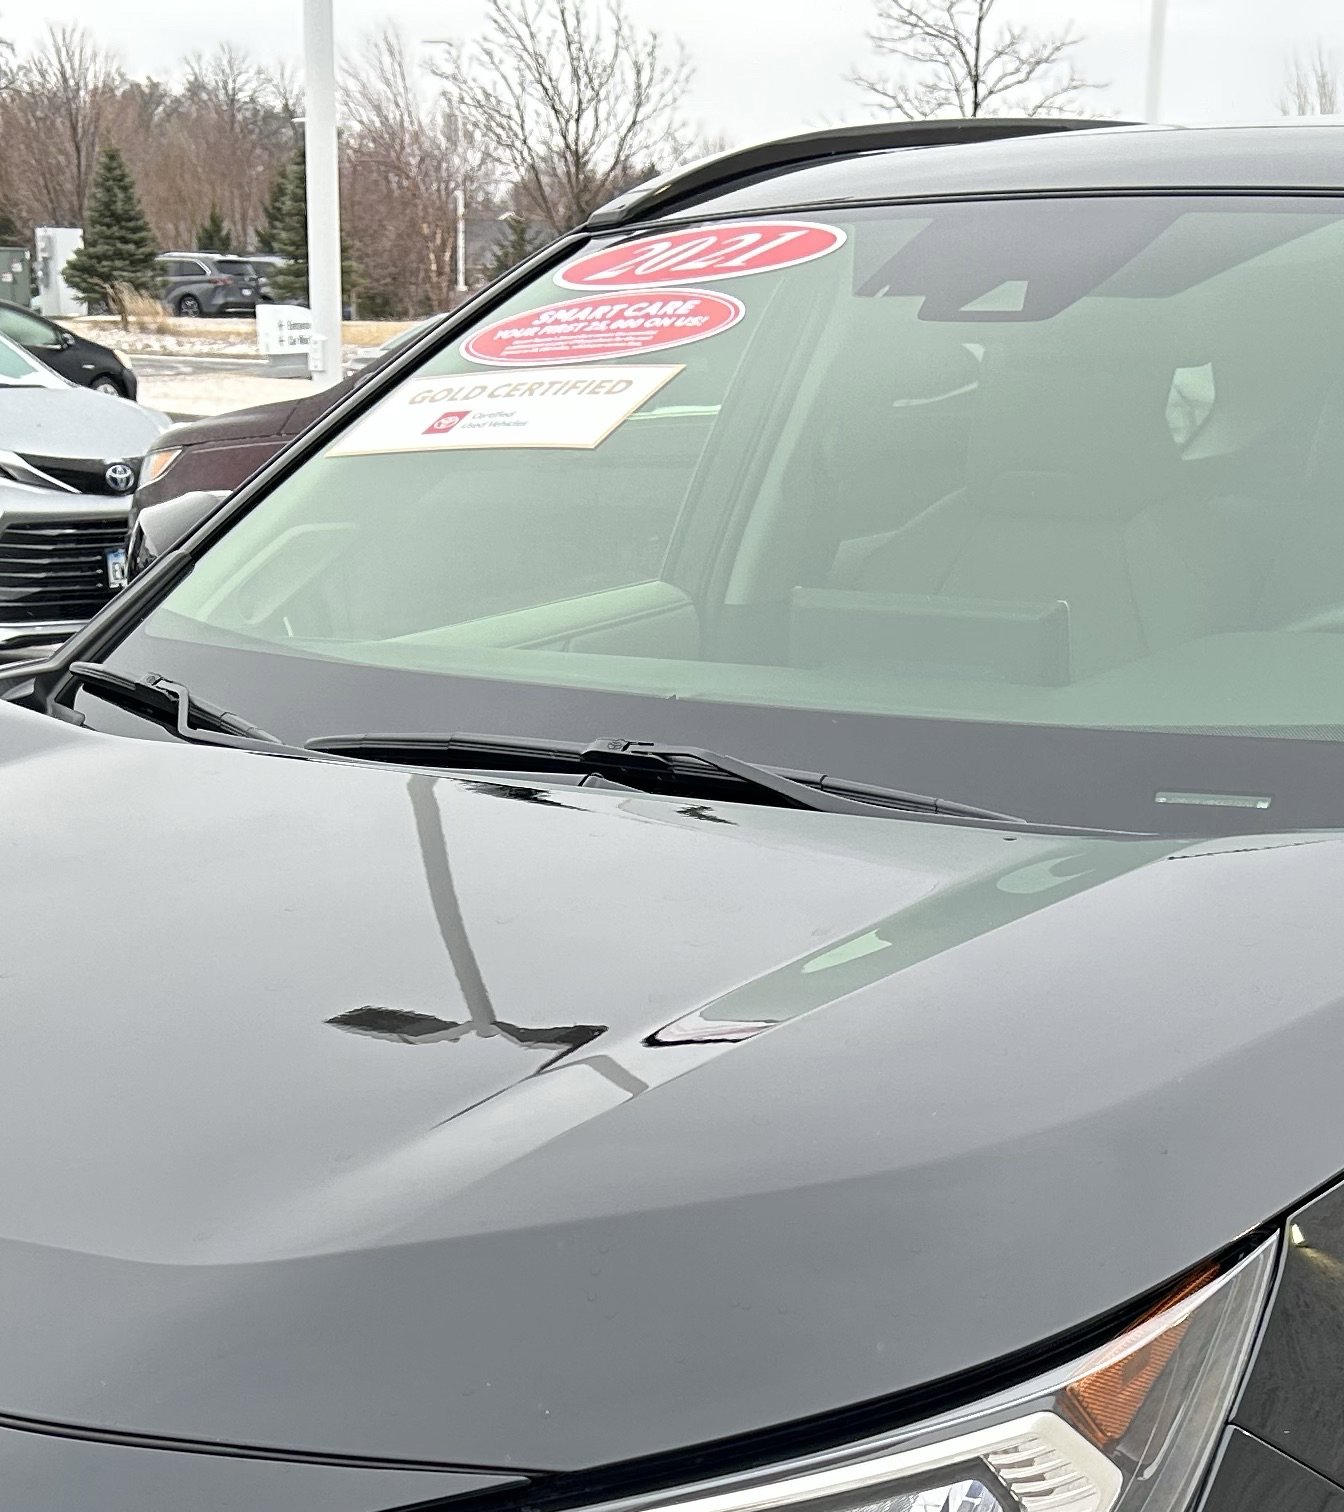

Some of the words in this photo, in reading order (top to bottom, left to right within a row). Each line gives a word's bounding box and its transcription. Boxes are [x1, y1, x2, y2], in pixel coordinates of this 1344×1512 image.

[582, 229, 810, 282] 2021
[531, 303, 625, 326] SMART
[623, 299, 702, 317] CARE
[493, 326, 543, 341] YOUR
[408, 384, 489, 405] GOLD
[487, 379, 634, 399] CERTIFIED
